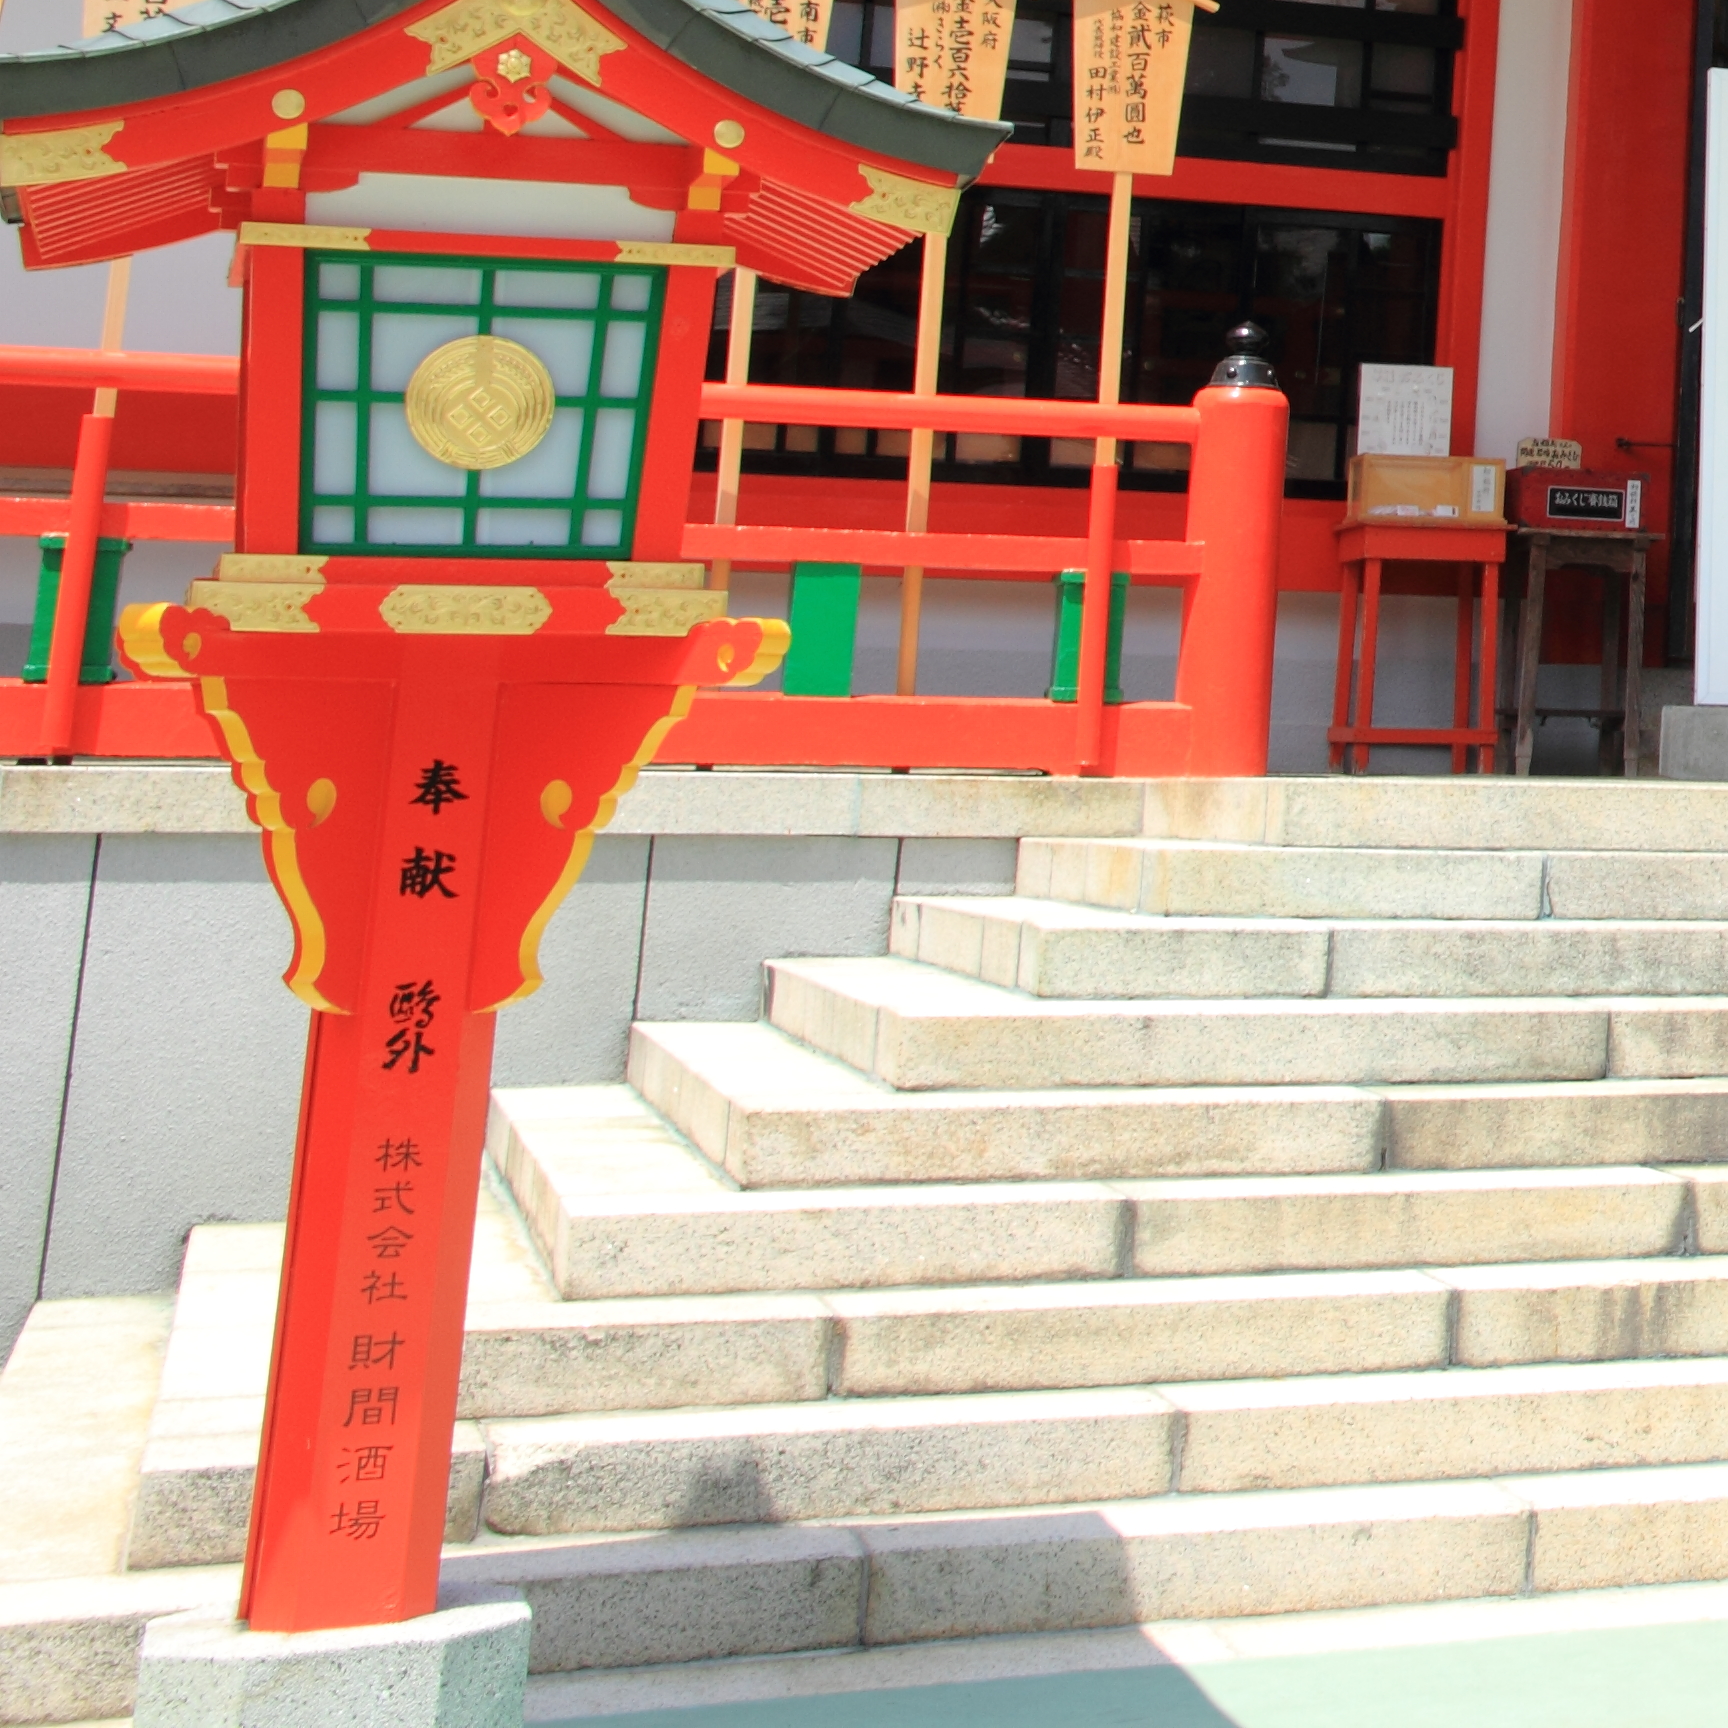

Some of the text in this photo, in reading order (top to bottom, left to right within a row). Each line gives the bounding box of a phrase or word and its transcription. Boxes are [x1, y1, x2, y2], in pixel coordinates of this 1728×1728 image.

[1155, 3, 1175, 49] 萩市
[397, 758, 470, 899] 奉献
[329, 1137, 423, 1541] 株式会社 財間酒場
